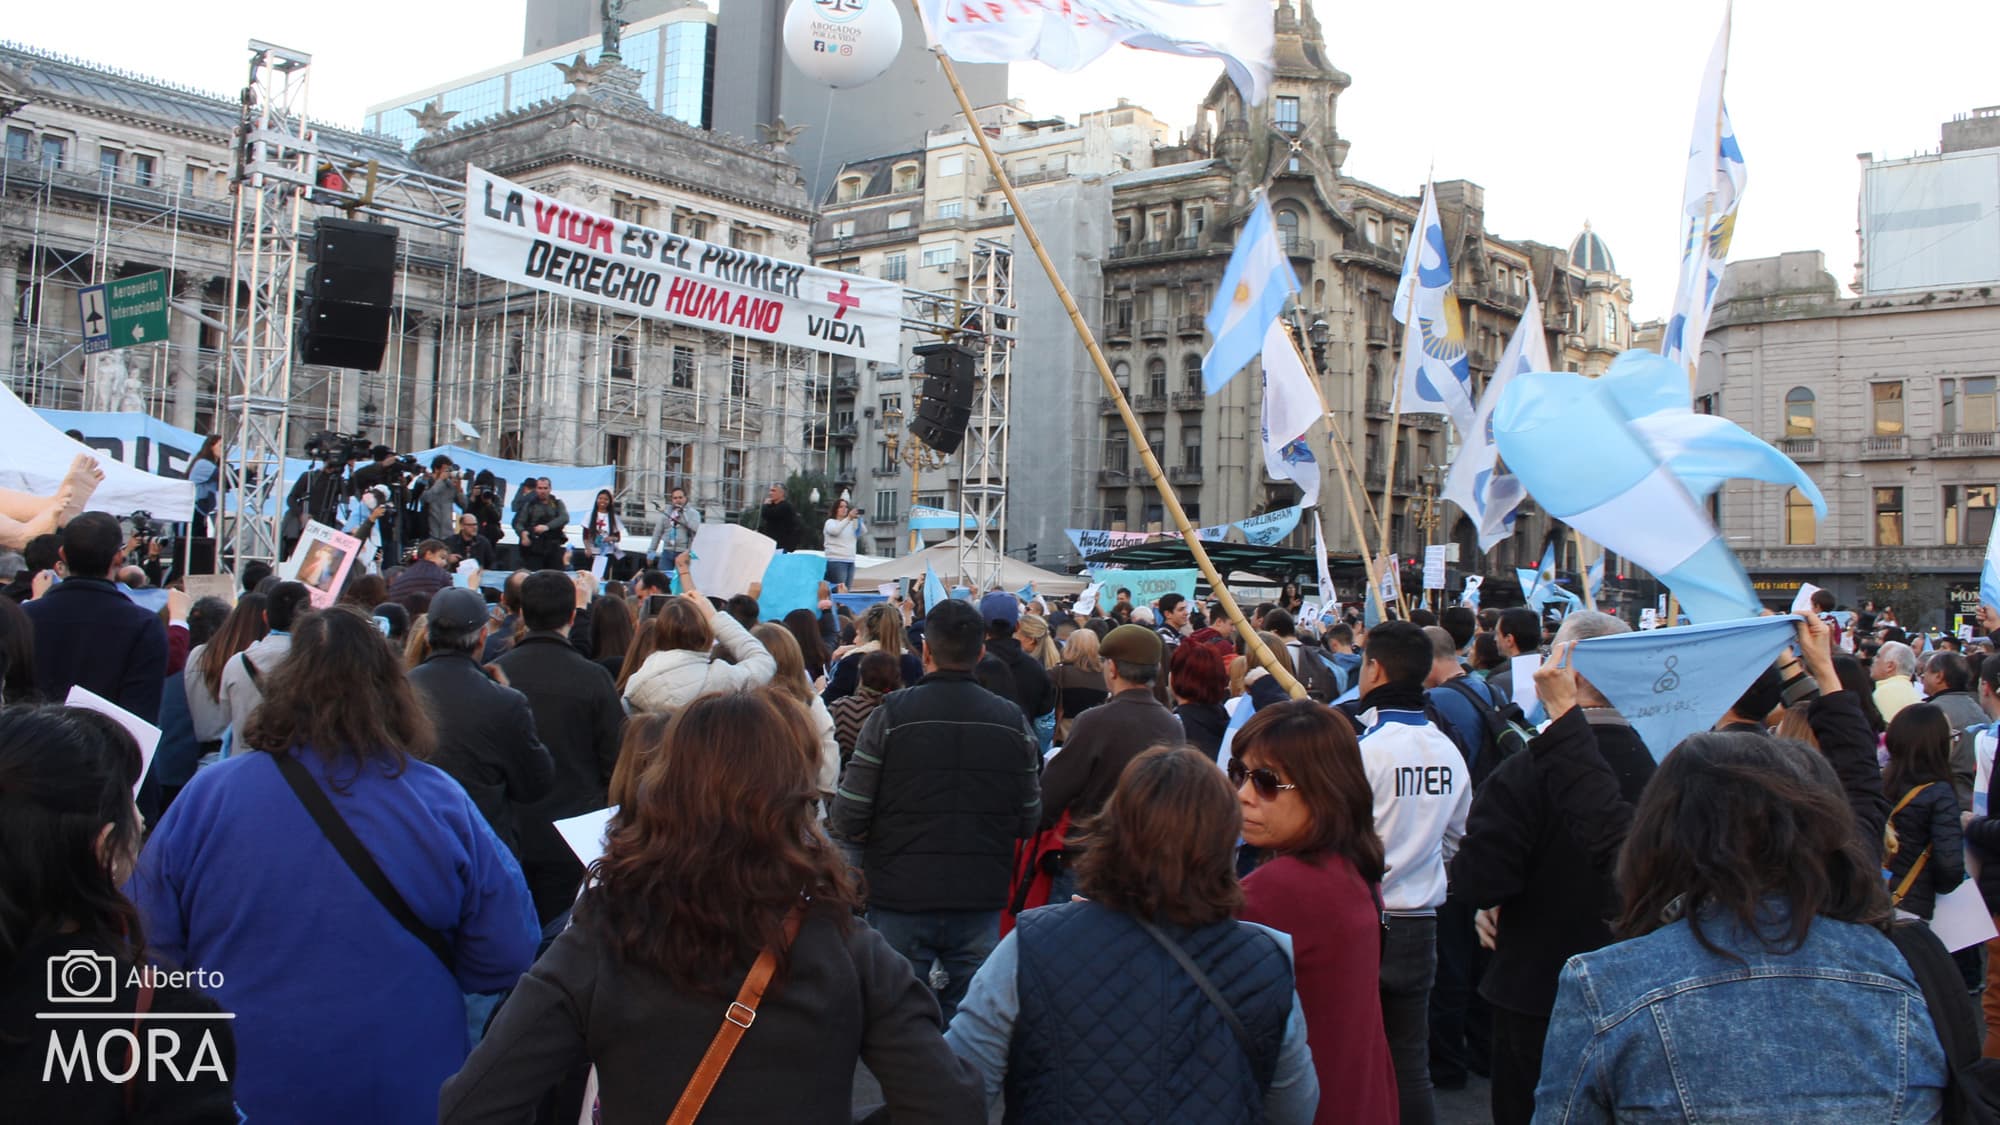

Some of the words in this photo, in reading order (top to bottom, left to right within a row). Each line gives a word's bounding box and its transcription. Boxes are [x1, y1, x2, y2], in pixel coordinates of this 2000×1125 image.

[810, 21, 862, 36] ABOGADOS
[484, 180, 525, 227] LA
[534, 198, 614, 254] VIDA
[620, 225, 659, 259] ES
[661, 234, 691, 270] EL
[700, 243, 805, 298] PRIMER
[112, 279, 158, 299] Aeropuerto
[525, 239, 661, 307] DERECHO
[665, 276, 784, 334] HUMANO
[111, 297, 163, 320] Internacional
[808, 314, 865, 348] VIDA
[1243, 507, 1293, 529] HURLINGHAM
[1395, 766, 1453, 797] INTER
